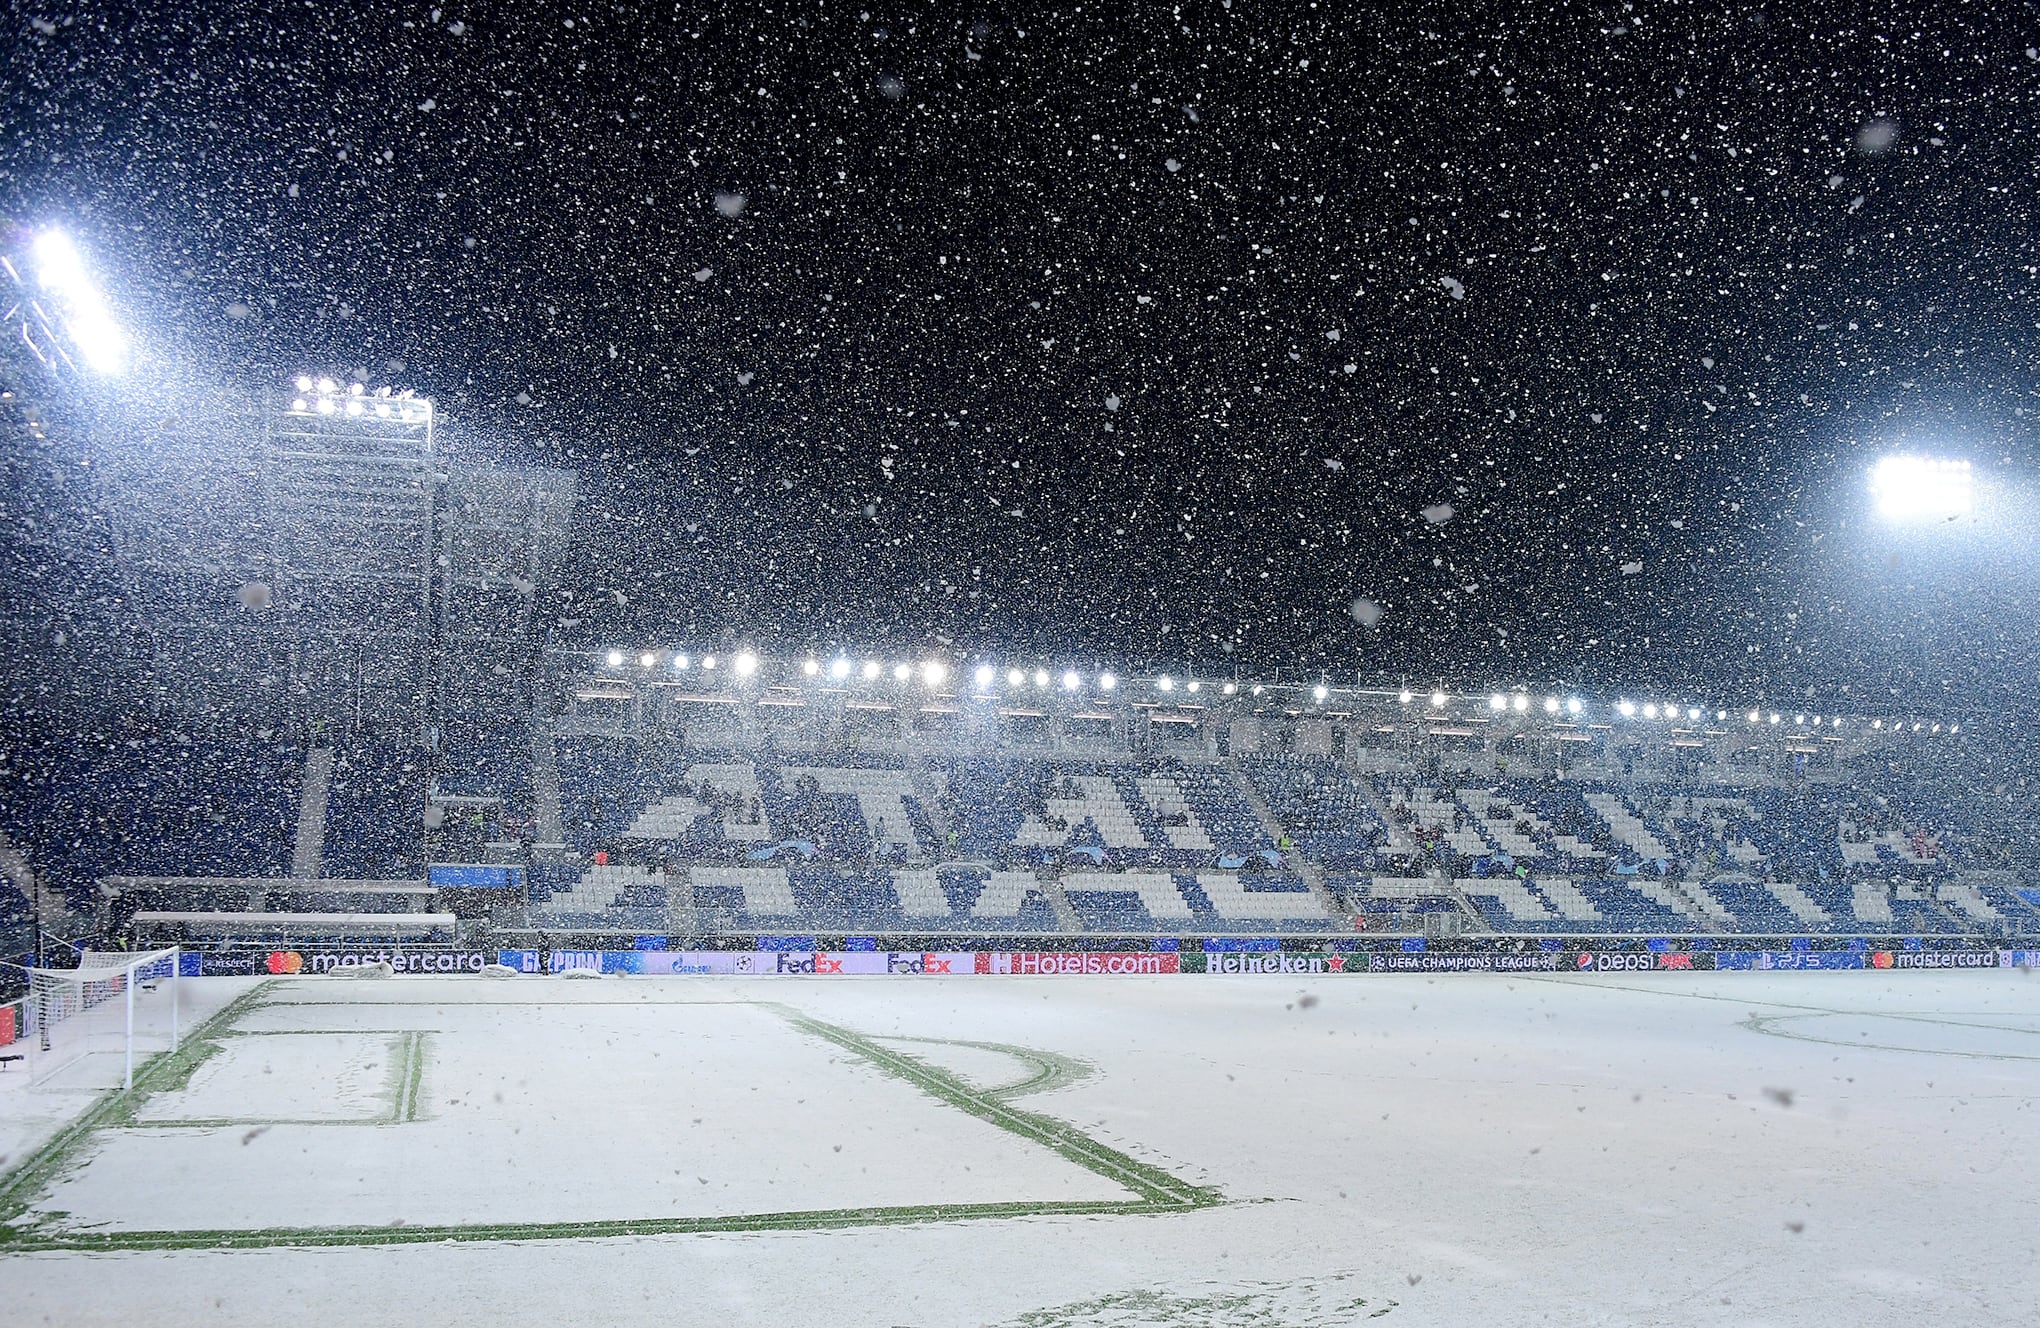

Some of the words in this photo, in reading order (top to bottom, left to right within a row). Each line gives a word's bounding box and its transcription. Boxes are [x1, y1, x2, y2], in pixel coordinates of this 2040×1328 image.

[312, 951, 485, 972] mastercard
[777, 952, 842, 973] FedEx
[1021, 952, 1160, 974] Hotels.com
[1206, 952, 1324, 973] Heineken
[1388, 958, 1418, 968] UEFA
[1422, 957, 1491, 970] CHAMPIONS
[1495, 957, 1537, 968] LEAGUE
[1598, 953, 1653, 972] pepsi
[1657, 952, 1694, 970] MAX
[1778, 955, 1820, 966] PS5
[1898, 951, 1993, 967] mastercard
